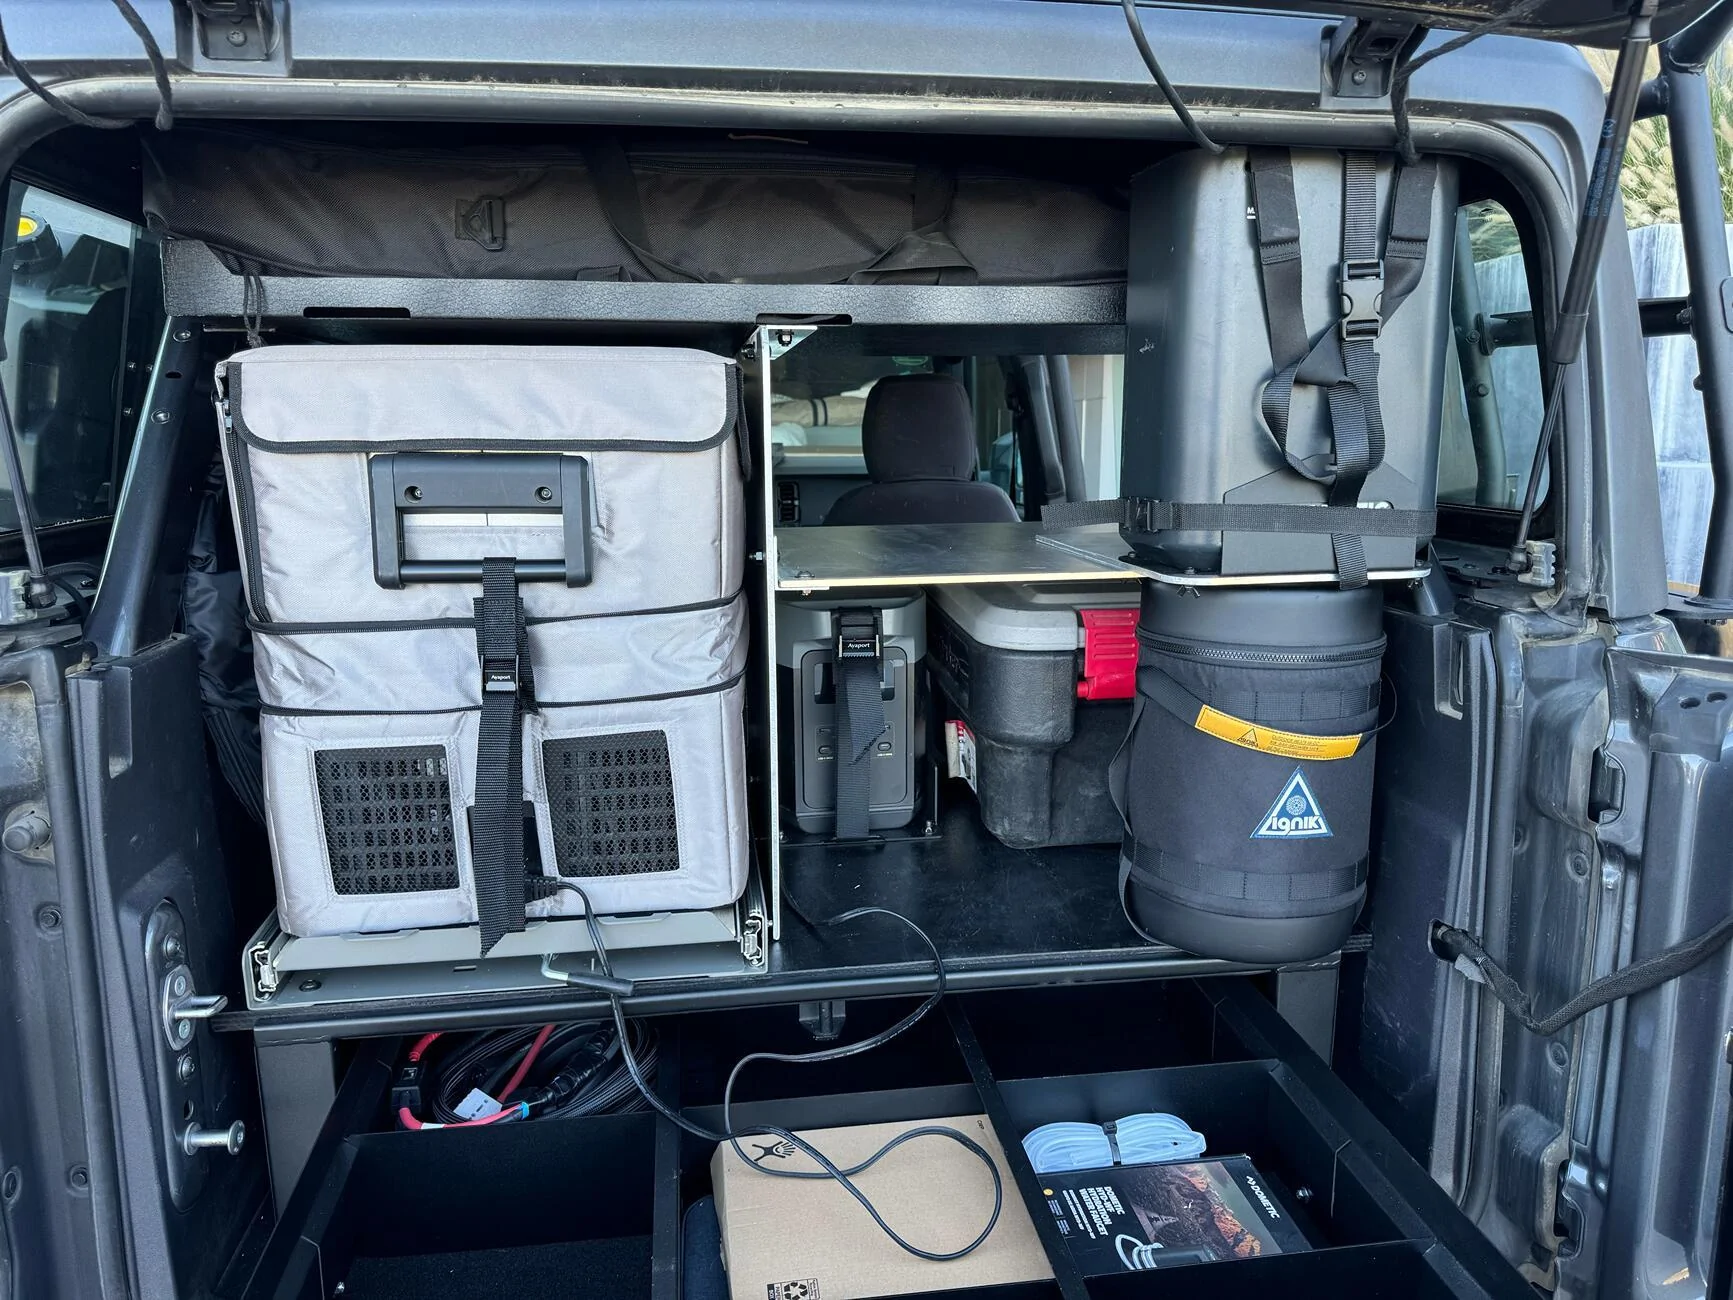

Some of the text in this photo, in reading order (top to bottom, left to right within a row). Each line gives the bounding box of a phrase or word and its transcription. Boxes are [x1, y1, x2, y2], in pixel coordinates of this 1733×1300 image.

[1079, 1188, 1096, 1211] WATER
[1089, 1208, 1109, 1236] FAUCET
[1086, 1187, 1113, 1225] HYDRATION
[1104, 1186, 1126, 1215] DOMETIC
[1250, 1185, 1281, 1219] DOMETIC
